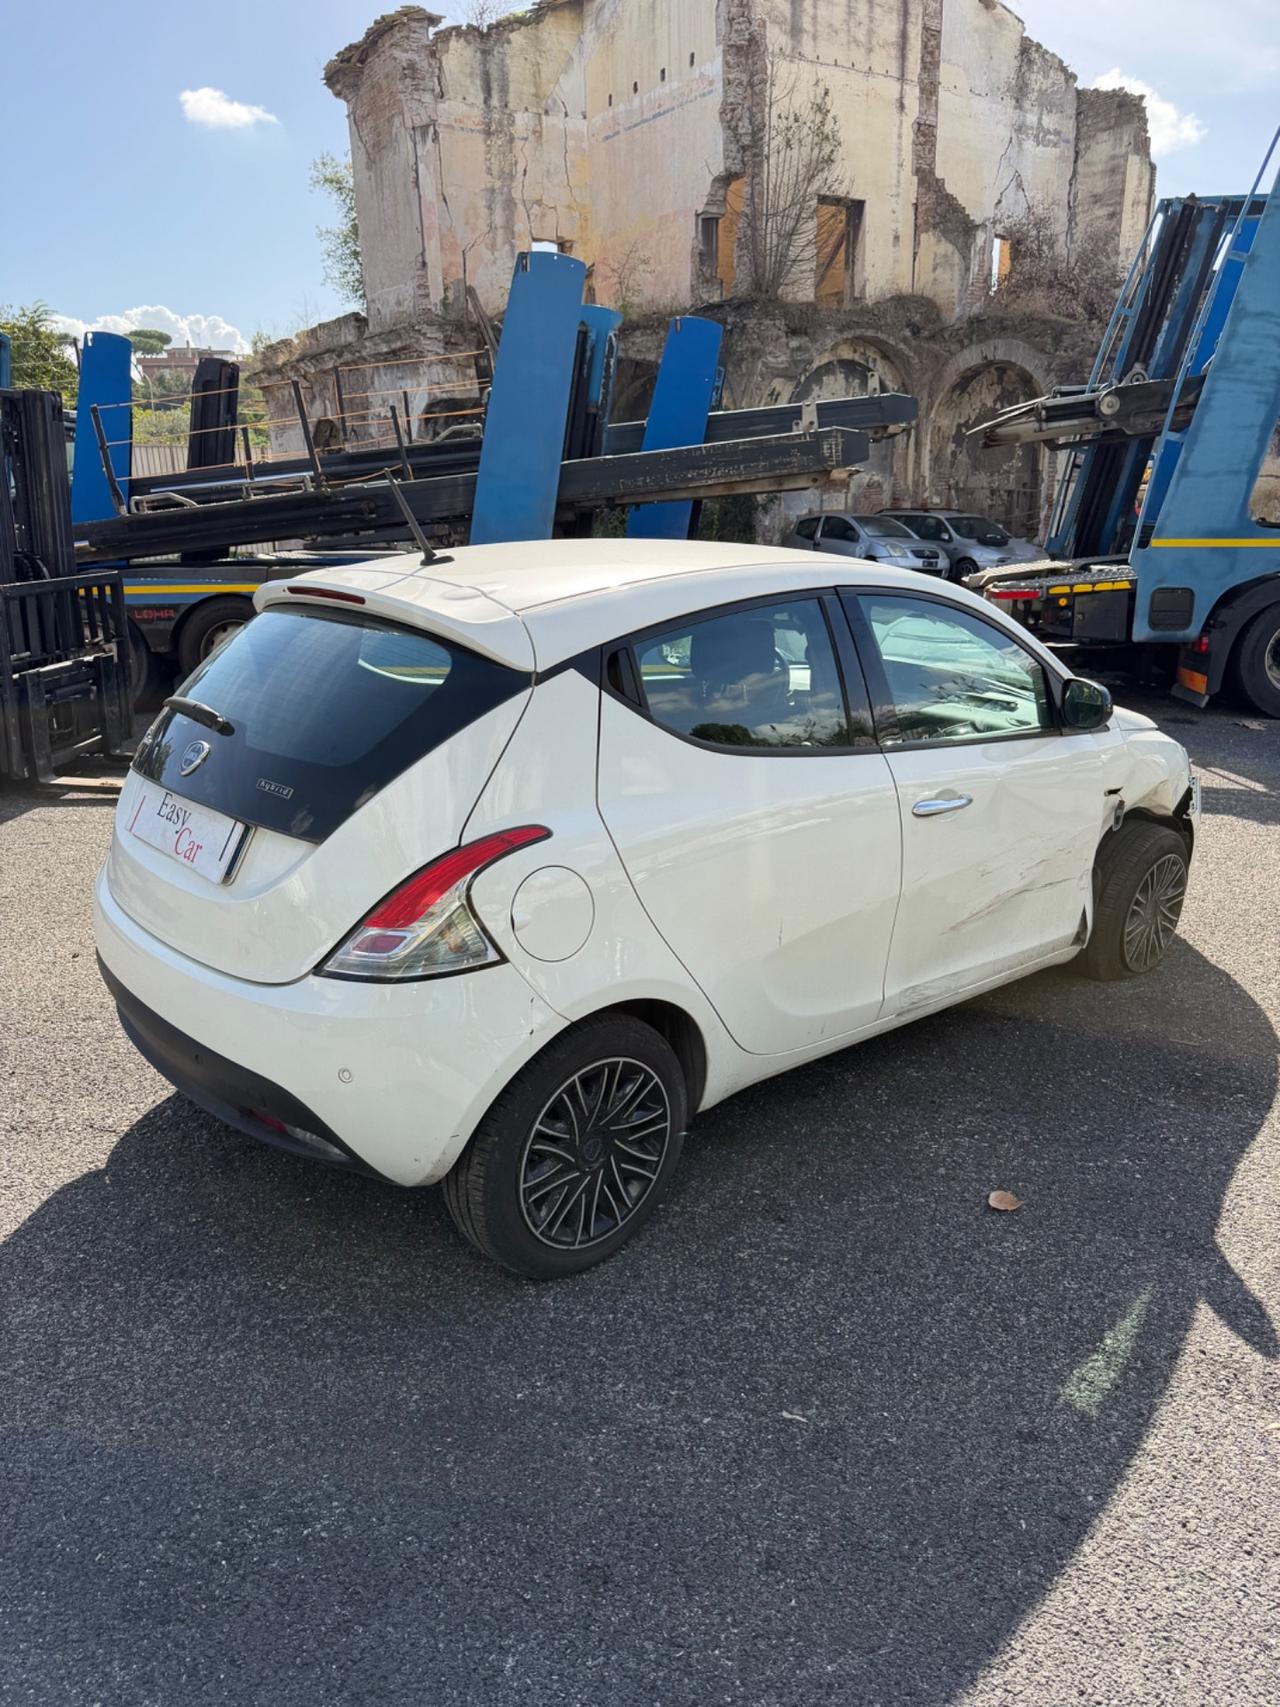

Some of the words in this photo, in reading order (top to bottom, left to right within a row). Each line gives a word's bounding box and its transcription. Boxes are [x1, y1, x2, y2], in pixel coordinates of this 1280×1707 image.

[260, 780, 290, 796] hybrid
[157, 792, 191, 834] Easy
[175, 827, 203, 863] Car
